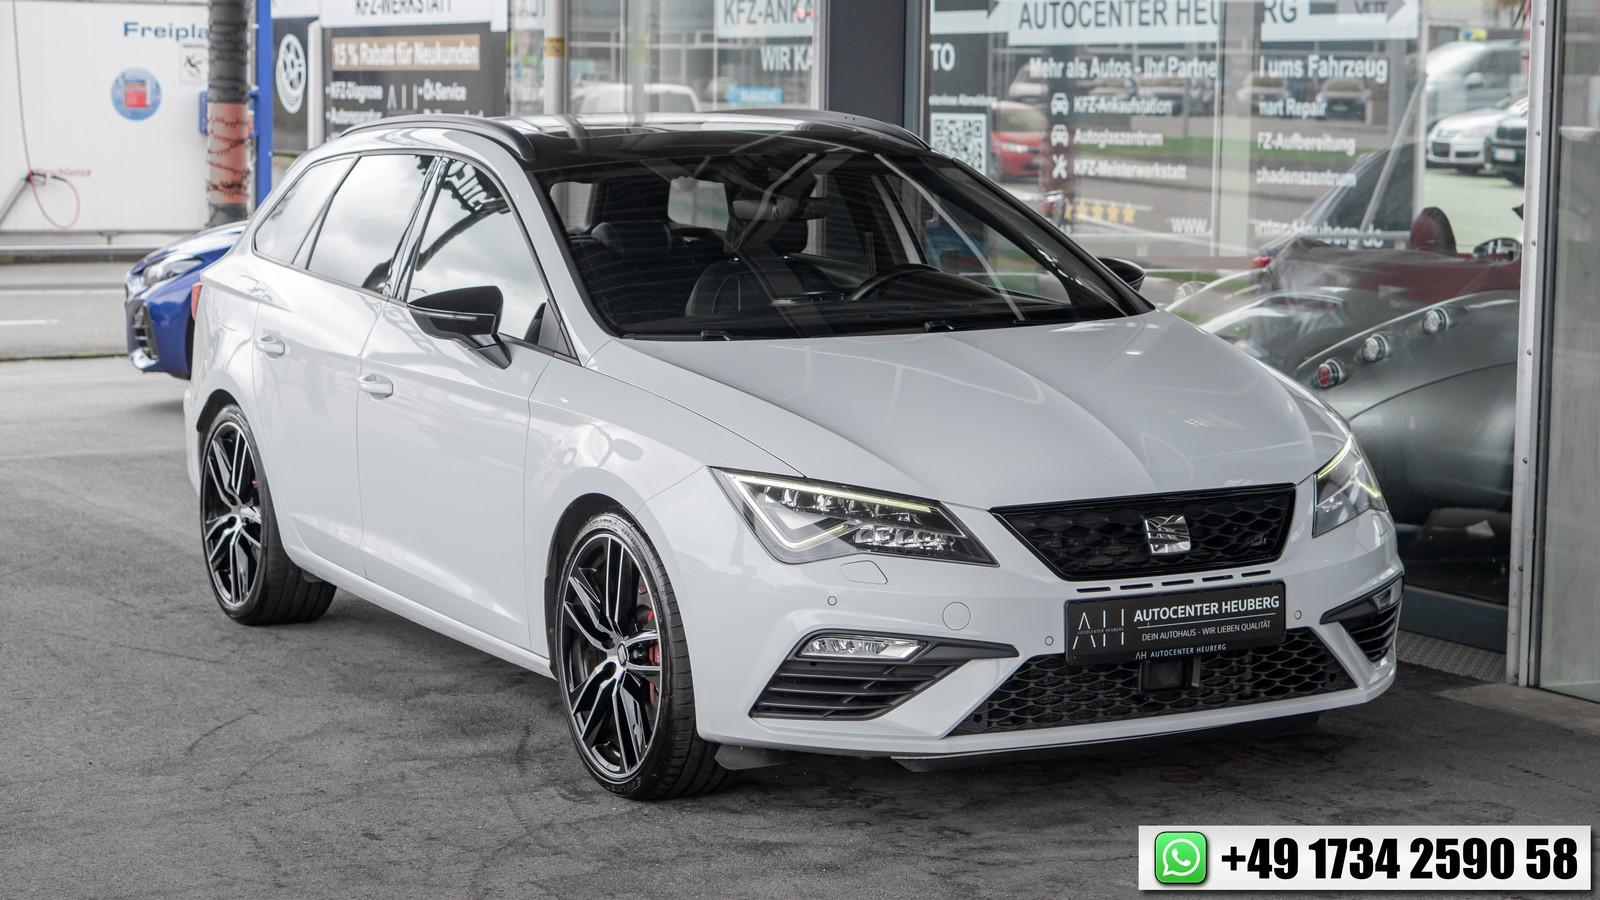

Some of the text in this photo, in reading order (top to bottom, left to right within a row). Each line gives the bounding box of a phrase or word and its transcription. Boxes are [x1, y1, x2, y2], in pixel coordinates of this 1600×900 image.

[1018, 0, 1168, 29] AUTOCENTER
[123, 22, 209, 41] Freipla
[360, 42, 395, 65] Rabatt
[397, 40, 412, 64] für
[414, 40, 479, 65] Neukunden
[761, 46, 791, 71] WIR
[1029, 57, 1063, 79] Mehr
[1066, 56, 1085, 78] als
[1089, 56, 1132, 79] Autos
[1144, 57, 1164, 77] Ihr
[1167, 56, 1218, 78] Partne
[1268, 62, 1304, 78] ums
[1307, 55, 1387, 84] Fahrzeug
[1073, 97, 1173, 115] KFZ-Ankaufstation
[1286, 98, 1328, 119] Repair
[1073, 128, 1163, 149] Autoglaszentrum
[1257, 132, 1356, 156] FZ-Aufbereitung
[1073, 159, 1187, 180] KFZ-Meisterwerkstatt
[1133, 595, 1280, 623] AUTOCENTER HEUBERG
[1072, 608, 1126, 650] AH
[1142, 633, 1159, 642] DEIN
[1160, 629, 1197, 640] AUTOHAUS
[1202, 626, 1216, 635] WIR
[1217, 624, 1240, 634] LIEBEN
[1242, 620, 1271, 633] QUALITÄT
[1151, 647, 1194, 659] AUTOCENTER
[1196, 644, 1226, 654] HEUBERG
